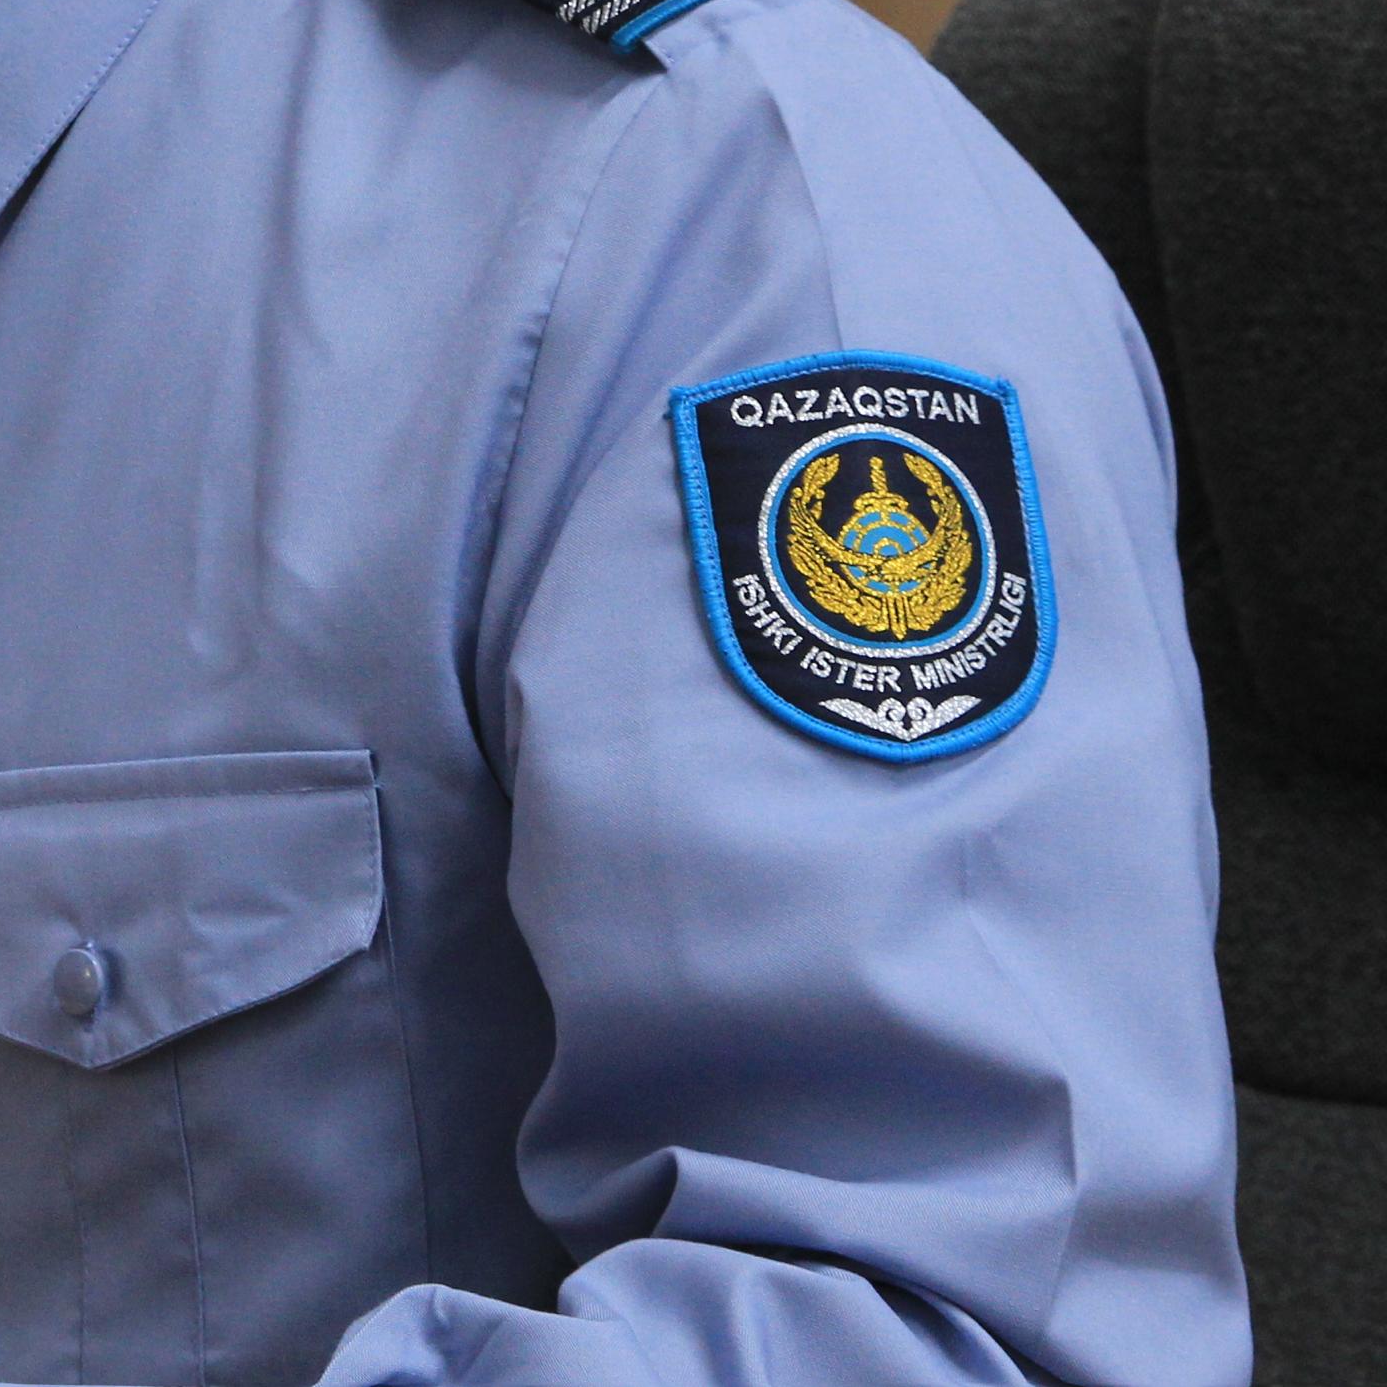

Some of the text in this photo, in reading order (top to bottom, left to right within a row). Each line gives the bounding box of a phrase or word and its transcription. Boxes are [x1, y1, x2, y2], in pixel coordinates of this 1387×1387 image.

[730, 385, 981, 427] QAZAQSTAN
[733, 572, 1027, 692] ISHKI ISTER MINISTRLIGI
